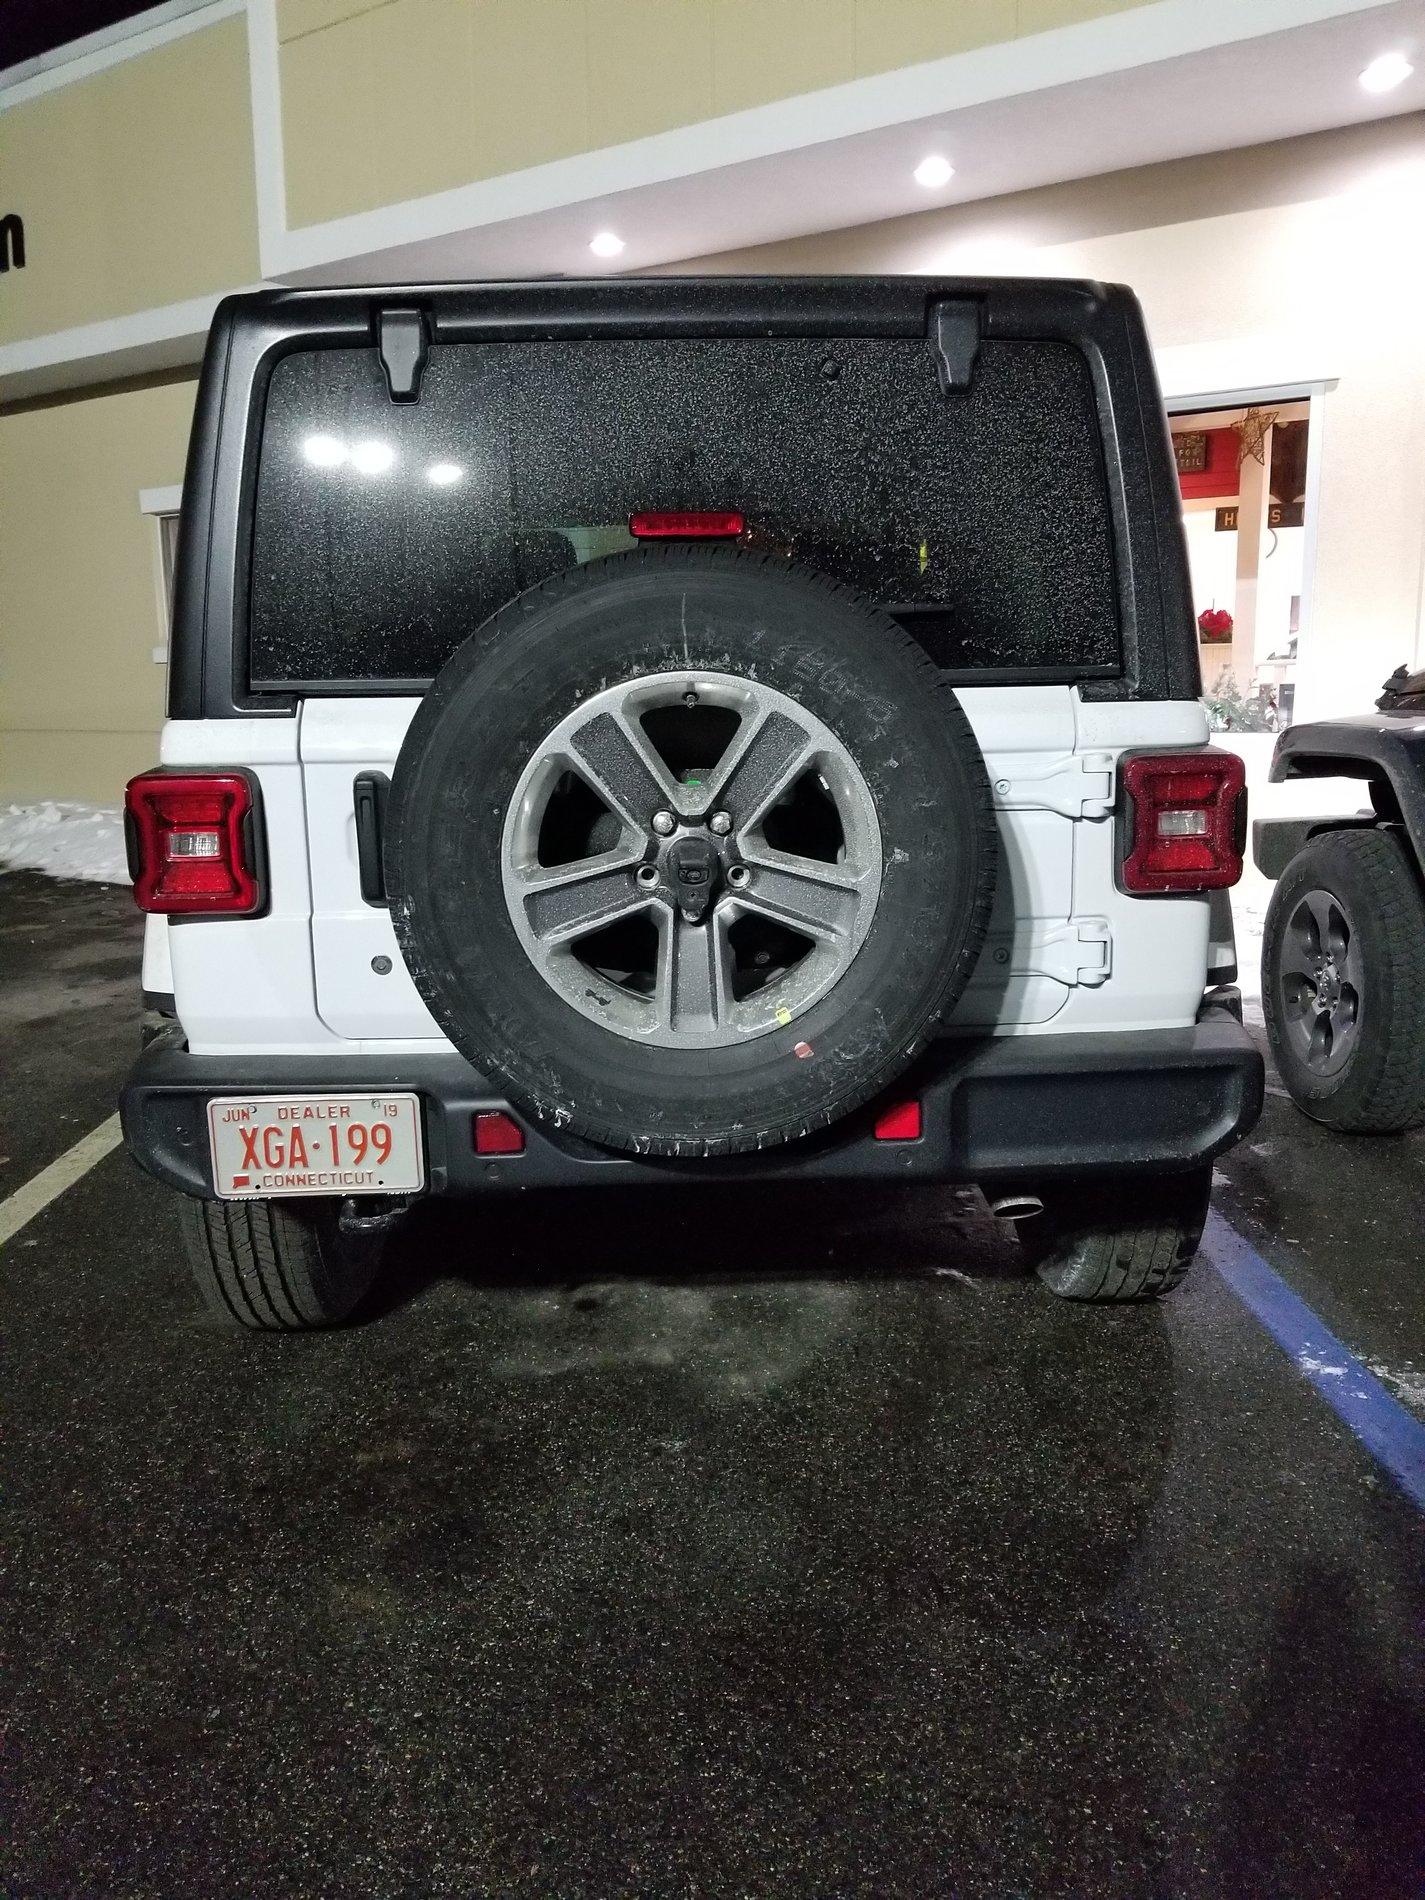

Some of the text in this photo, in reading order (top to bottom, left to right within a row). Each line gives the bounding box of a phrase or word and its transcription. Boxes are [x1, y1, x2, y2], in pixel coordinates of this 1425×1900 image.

[222, 1104, 398, 1123] JUN DEALER 19
[262, 1171, 374, 1188] CONNECTICUT
